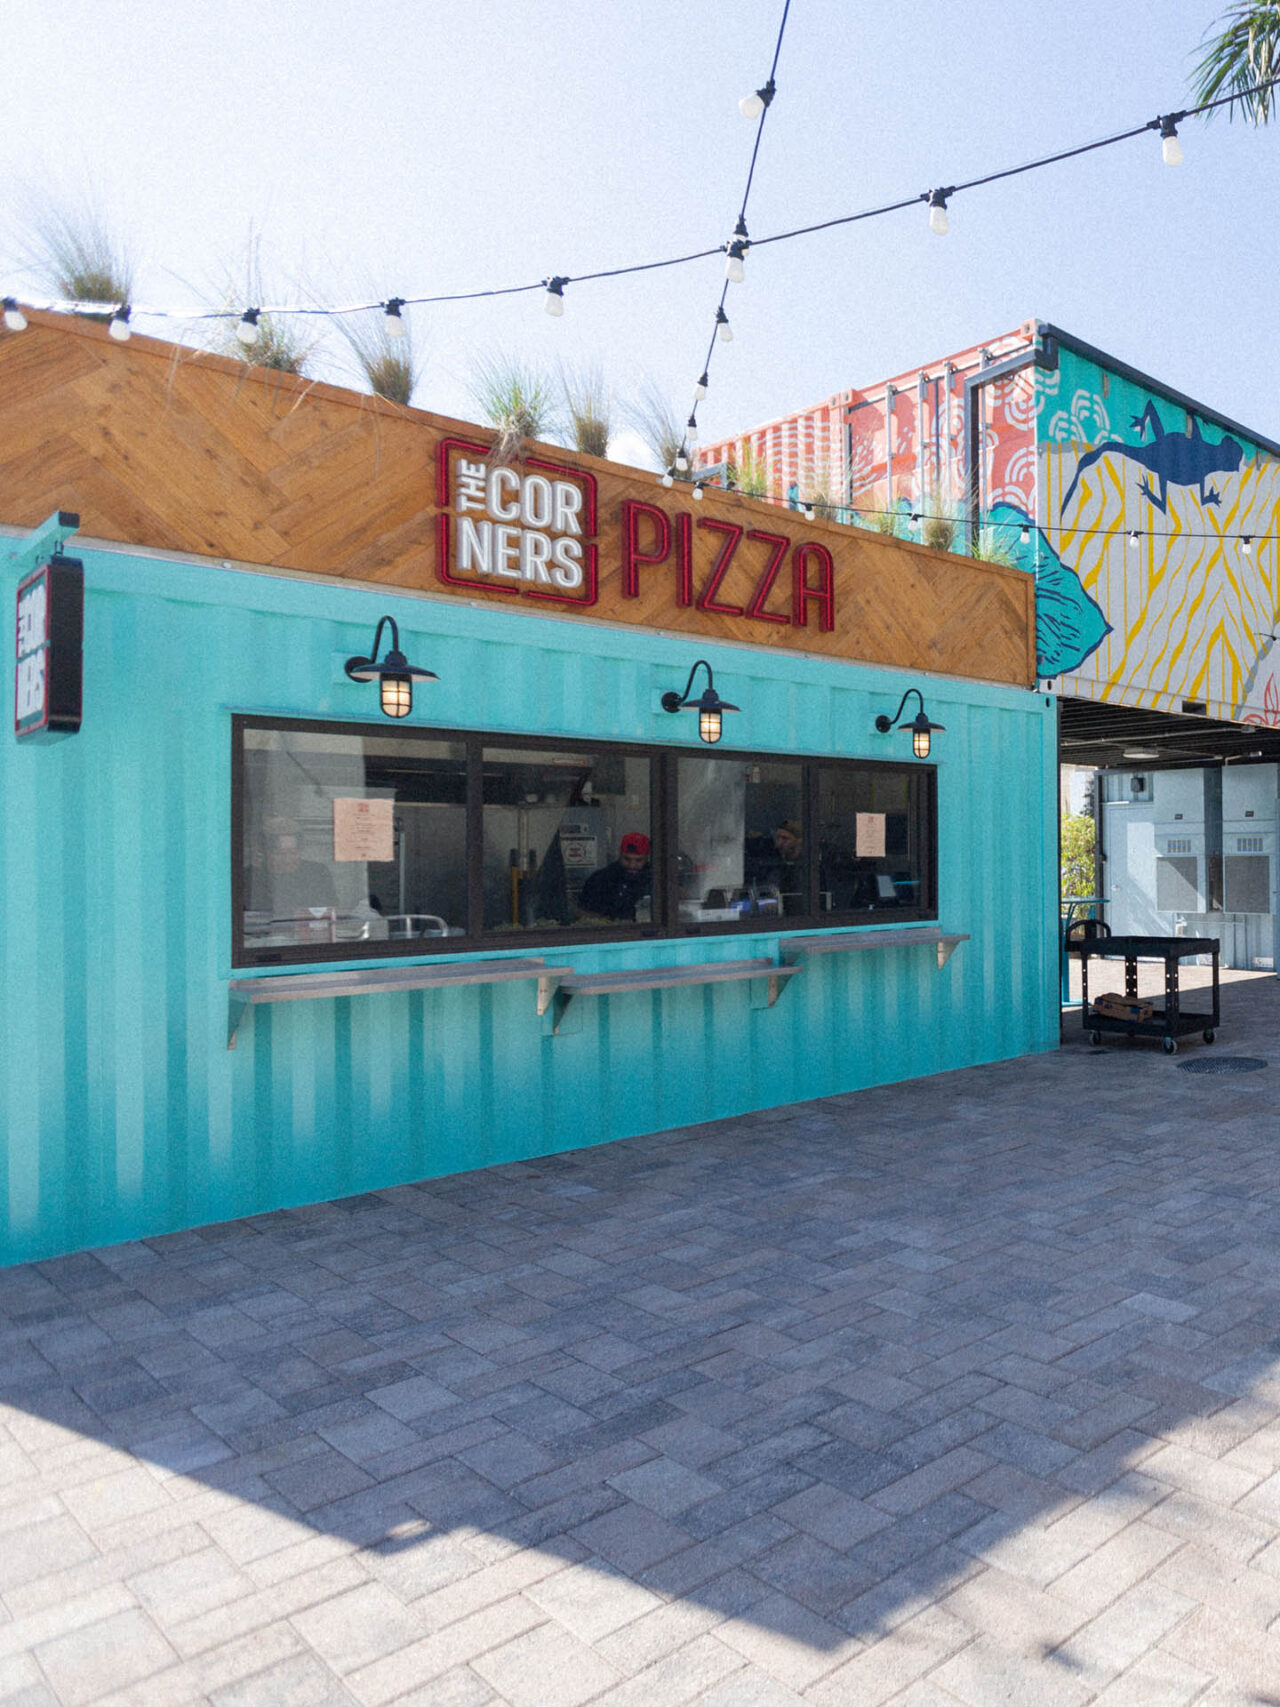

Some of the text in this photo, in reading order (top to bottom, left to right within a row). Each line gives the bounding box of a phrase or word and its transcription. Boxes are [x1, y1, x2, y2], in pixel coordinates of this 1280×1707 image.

[456, 458, 487, 512] THE
[486, 466, 583, 536] COR
[456, 516, 583, 589] NERS
[621, 500, 835, 632] PIZZA
